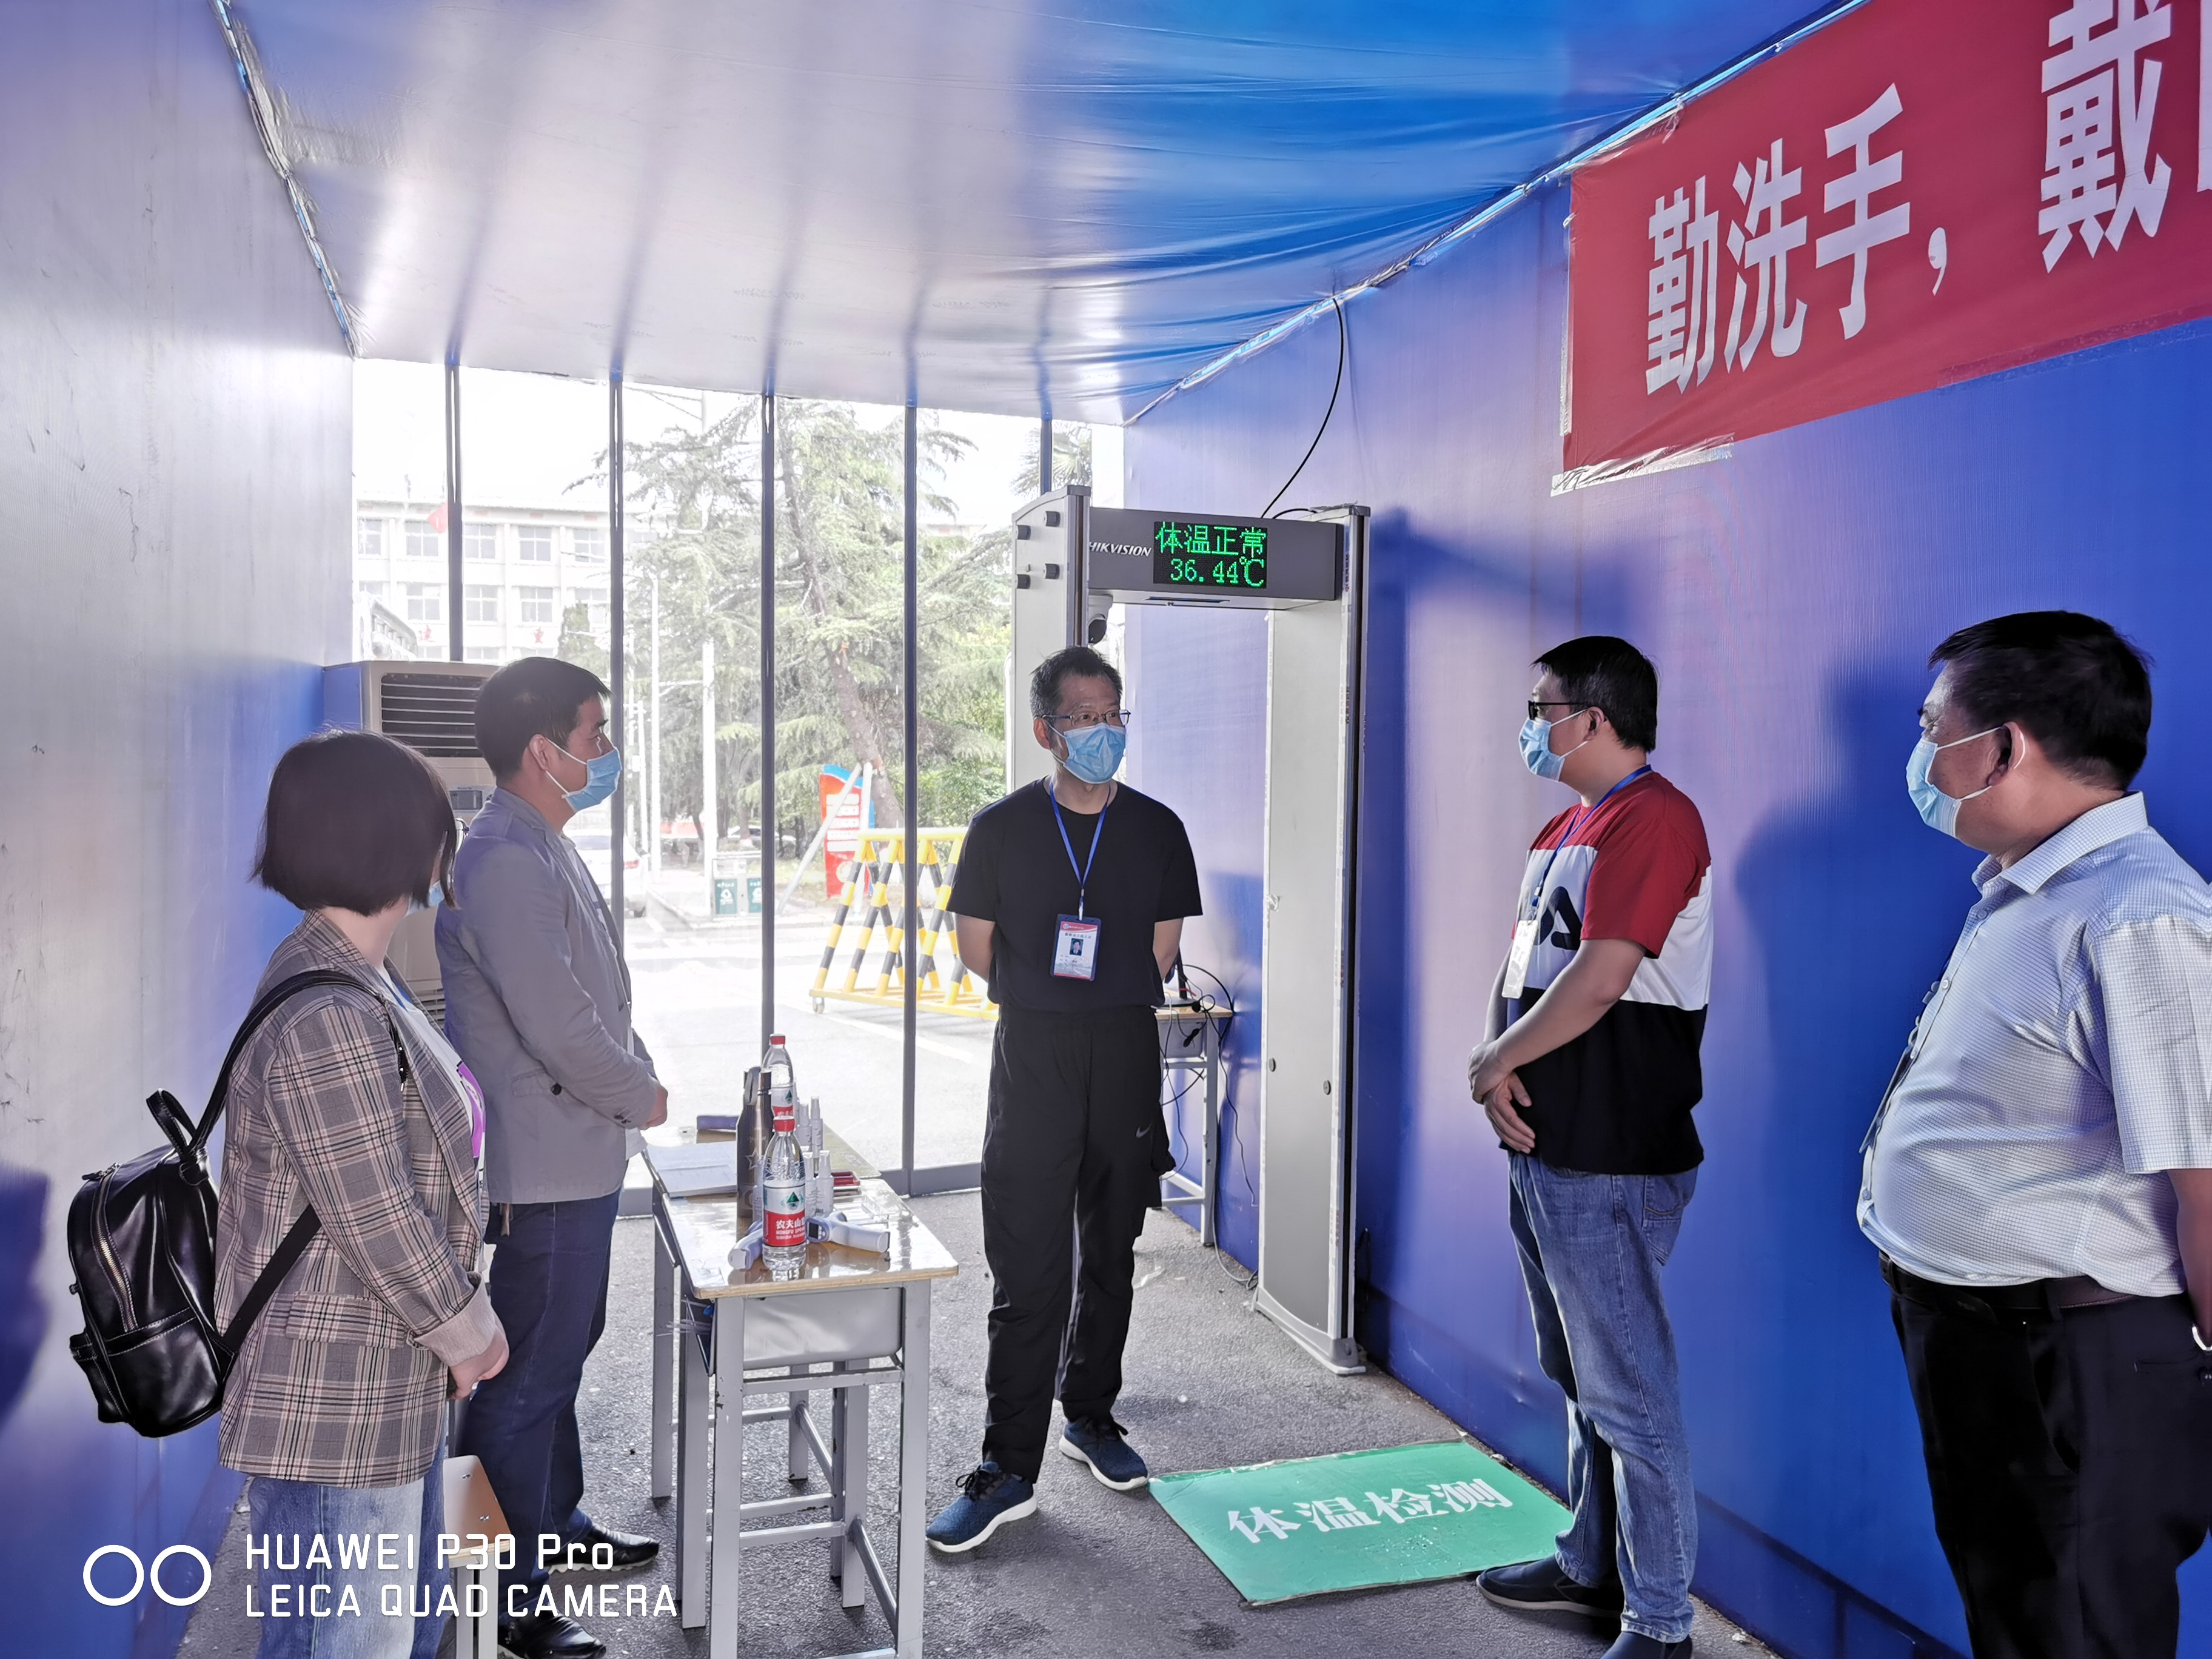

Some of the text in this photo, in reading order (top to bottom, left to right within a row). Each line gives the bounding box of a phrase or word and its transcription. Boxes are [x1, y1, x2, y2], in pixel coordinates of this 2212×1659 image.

[1645, 0, 2212, 395] 勤洗手，戴
[1089, 541, 1151, 557] HIKVISION
[1155, 521, 1267, 558] 体温正常
[1228, 1478, 1513, 1544] 体温检测
